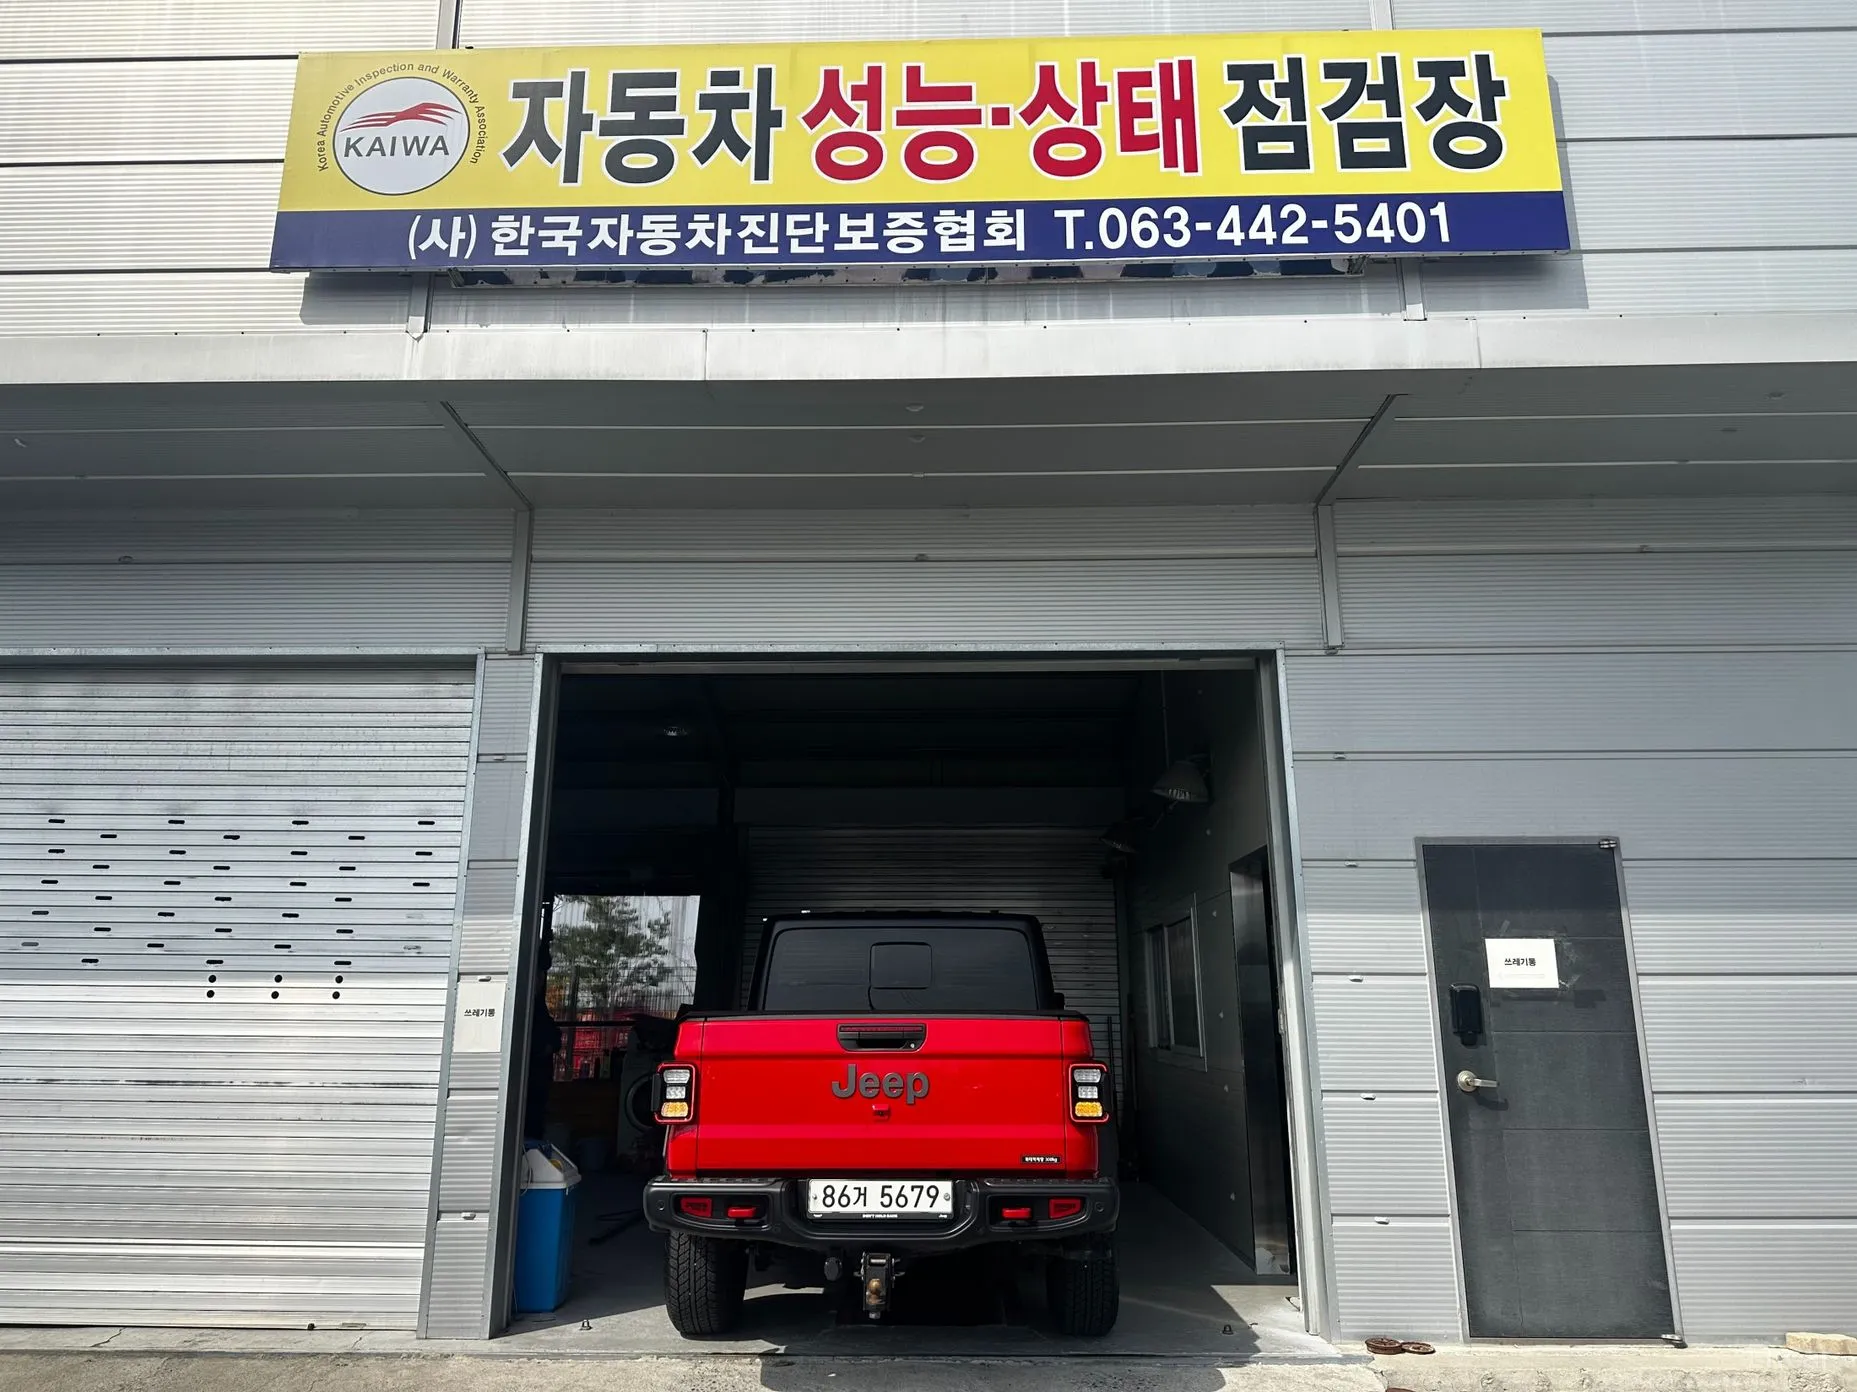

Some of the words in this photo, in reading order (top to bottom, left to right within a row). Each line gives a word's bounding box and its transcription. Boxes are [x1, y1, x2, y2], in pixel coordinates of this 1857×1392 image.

[355, 63, 414, 87] Inspection
[417, 63, 440, 75] and
[442, 69, 479, 104] Warranty
[317, 84, 355, 137] Automotive
[503, 67, 783, 185] 자동차
[1222, 53, 1507, 171] 점검장
[344, 135, 450, 157] KAIWA
[470, 105, 488, 164] Association
[317, 140, 329, 172] Korea
[407, 214, 478, 260] (사)
[491, 208, 1026, 257] 한국자동차진단보증협회
[1053, 202, 1452, 250] T.063-442-5401
[1504, 957, 1537, 967] 쓰레기통
[463, 1008, 496, 1018] 쓰레기통
[831, 1063, 930, 1105] Jeep
[822, 1184, 867, 1208] 86거
[879, 1184, 940, 1208] 5679
